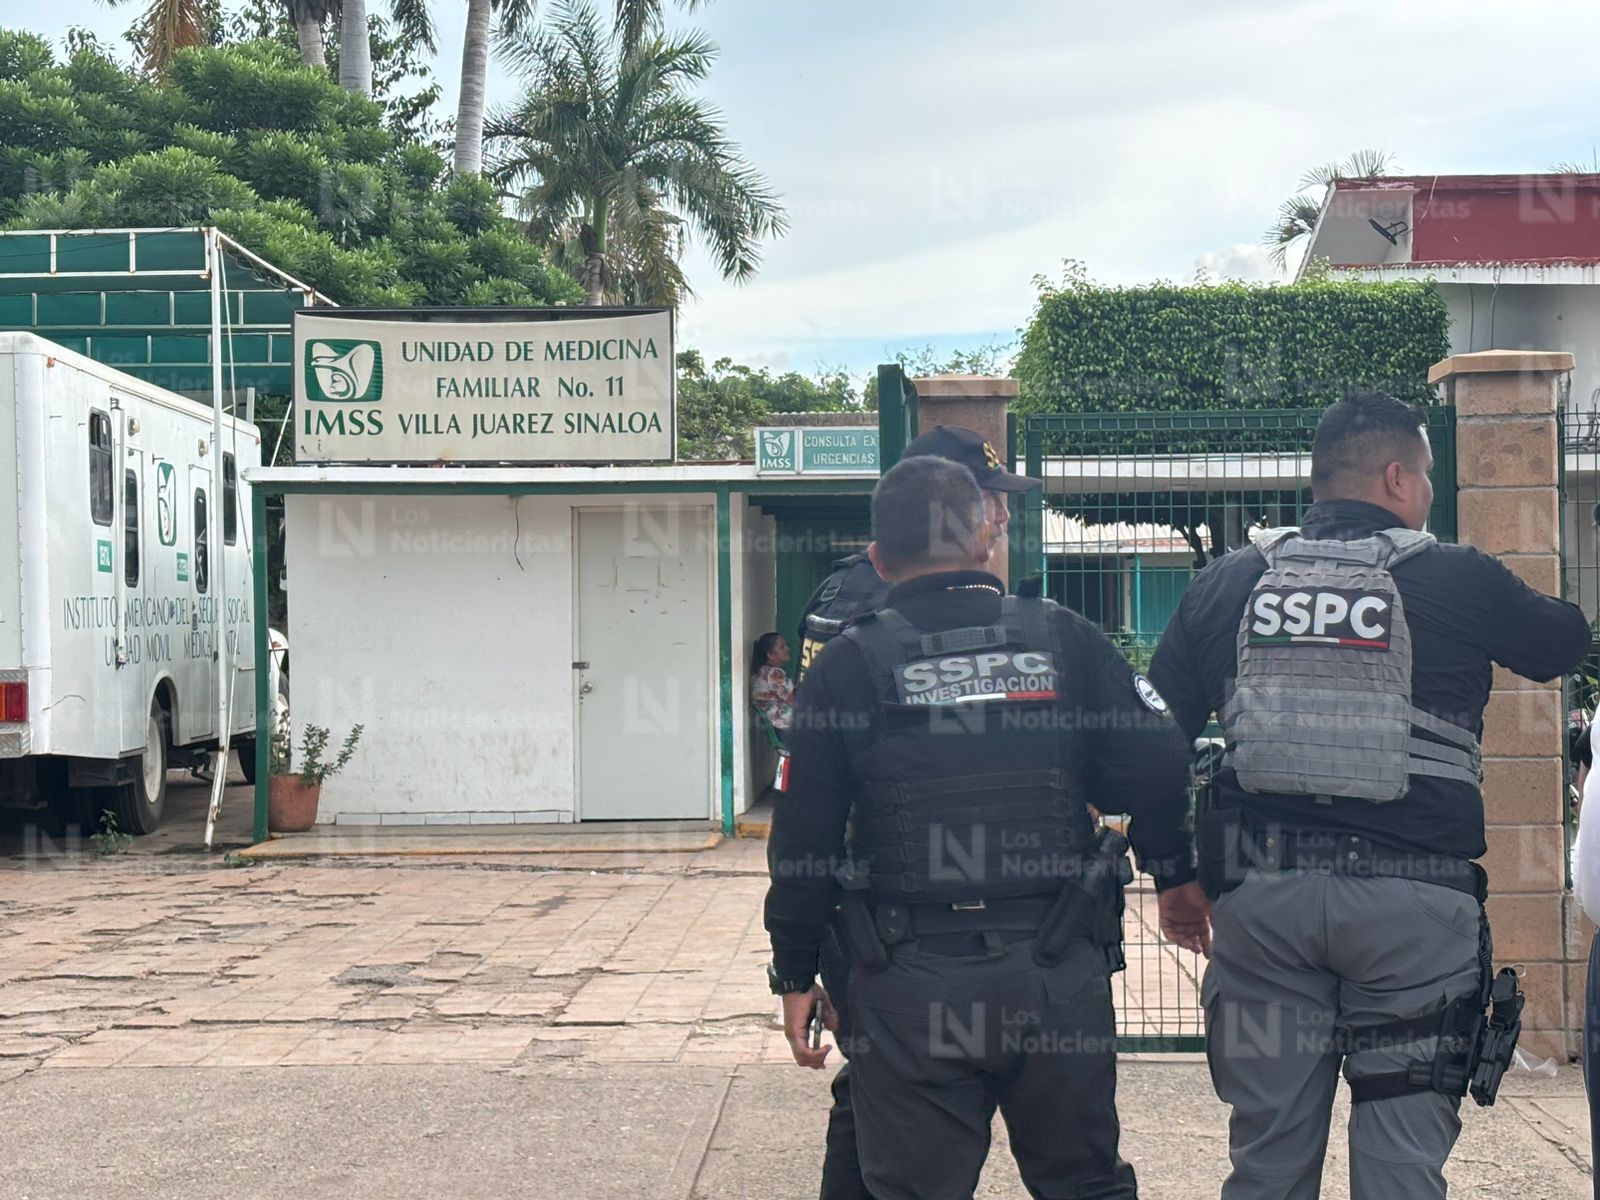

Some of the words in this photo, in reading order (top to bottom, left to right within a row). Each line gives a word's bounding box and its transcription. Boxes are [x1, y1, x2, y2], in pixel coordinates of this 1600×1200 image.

[402, 340, 494, 362] UNIDAD
[505, 341, 534, 362] DE
[544, 338, 659, 361] MEDICINA
[436, 376, 540, 399] FAMILIAR
[558, 377, 594, 398] No.
[605, 376, 624, 397] 11
[304, 409, 384, 436] IMSS
[398, 413, 461, 435] VILLA
[471, 412, 554, 438] JUAREZ
[564, 411, 663, 434] SINALOA
[804, 435, 857, 447] CONSULTA
[864, 435, 877, 447] EX
[762, 458, 792, 468] IMSS
[813, 453, 875, 464] URGENCIAS
[63, 596, 119, 630] INSTITUTO
[1252, 592, 1388, 639] SSPC
[104, 633, 141, 666] UNDAD
[903, 652, 1050, 692] SSPC
[906, 675, 1054, 705] INVESTIGACIÓN
